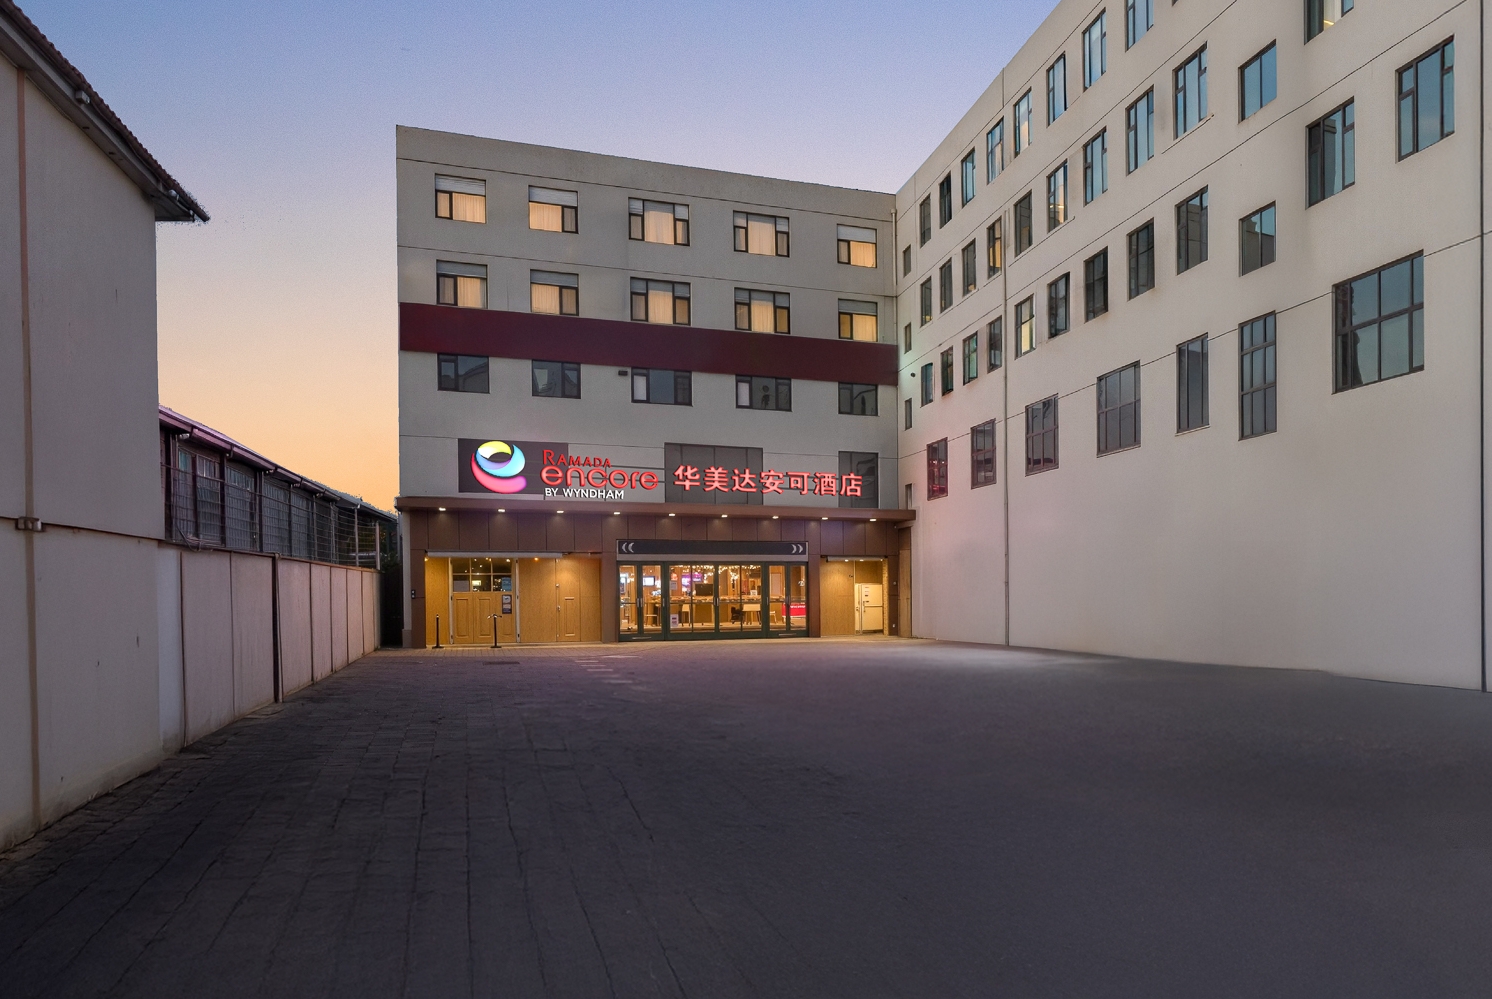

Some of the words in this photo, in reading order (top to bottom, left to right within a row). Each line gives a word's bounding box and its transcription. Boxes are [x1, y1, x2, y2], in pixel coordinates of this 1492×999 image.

[543, 449, 612, 468] RAMADA
[540, 465, 659, 490] encore
[674, 464, 863, 497] 华美达安可酒店
[545, 488, 558, 497] BY
[563, 488, 625, 499] WYNDHAM
